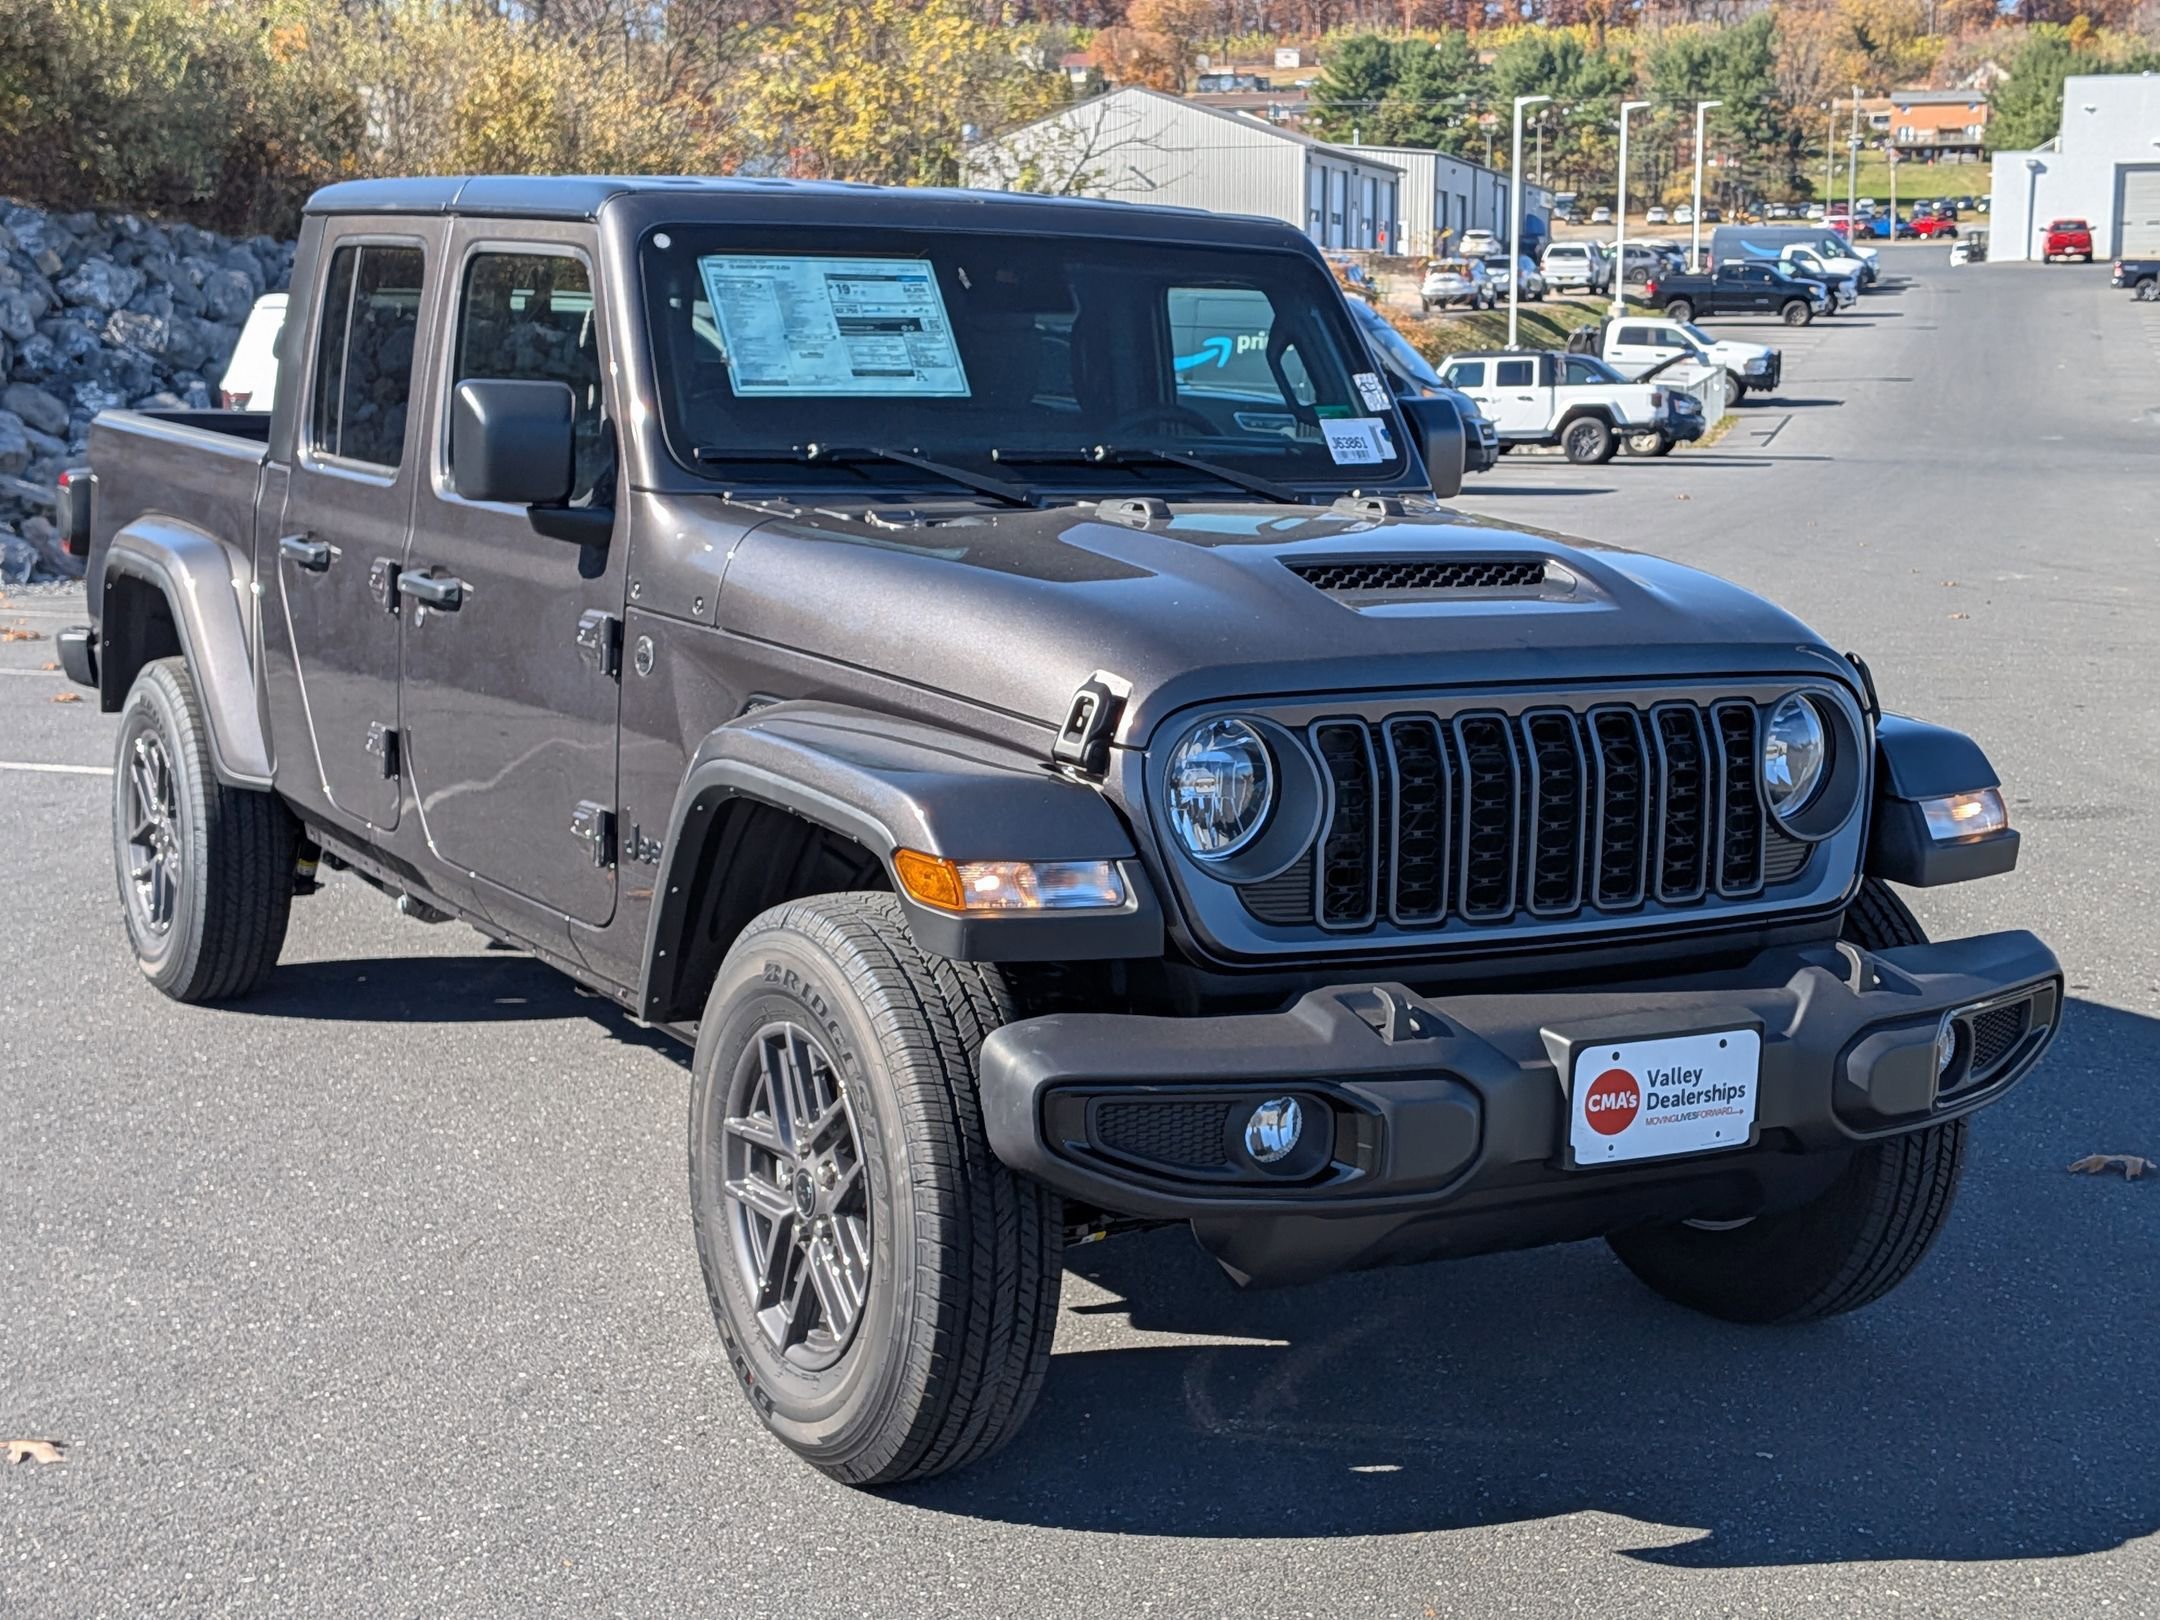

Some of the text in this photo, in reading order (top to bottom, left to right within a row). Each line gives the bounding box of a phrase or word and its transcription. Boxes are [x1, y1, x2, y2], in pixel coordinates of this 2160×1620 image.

[1647, 1067, 1703, 1088] Valley
[1588, 1090, 1638, 1113] CMA's
[1646, 1082, 1746, 1111] Dealerships
